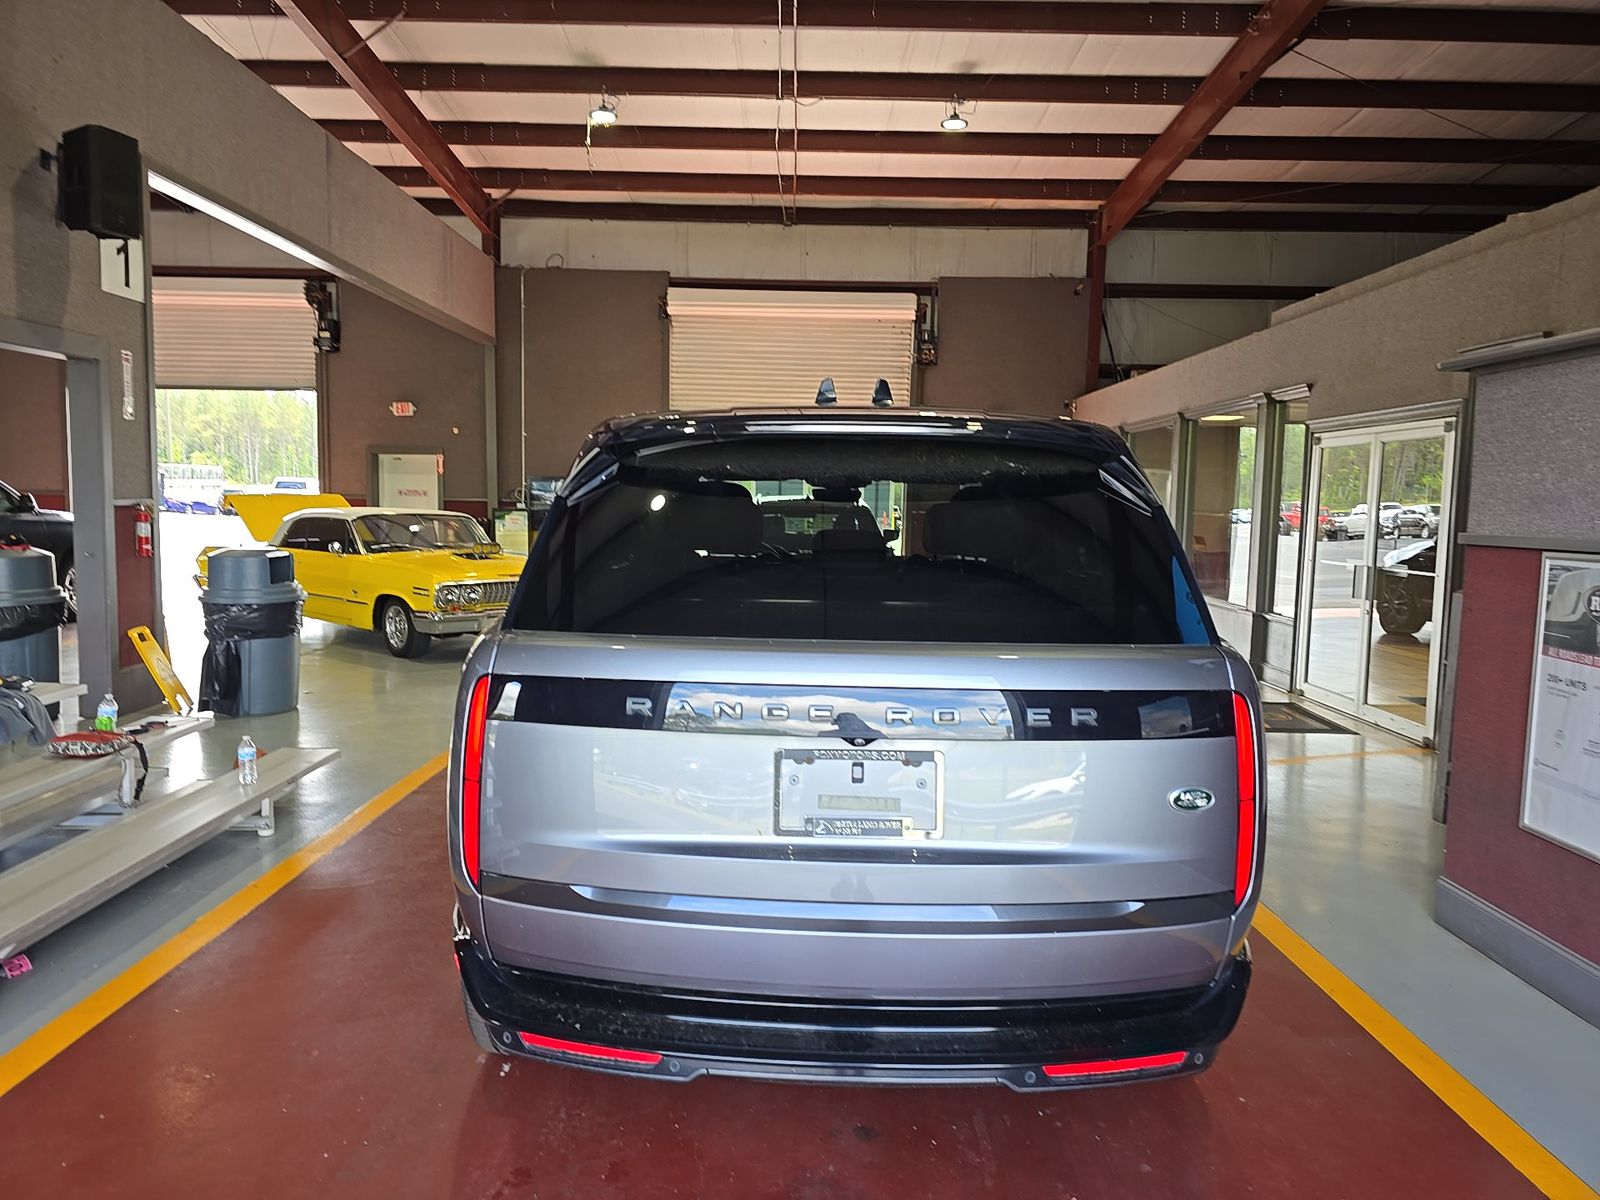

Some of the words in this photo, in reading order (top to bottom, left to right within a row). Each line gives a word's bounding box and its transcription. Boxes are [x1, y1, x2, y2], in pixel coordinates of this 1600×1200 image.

[116, 239, 131, 288] 1
[626, 696, 835, 722] RANGE
[885, 706, 1099, 728] ROVER
